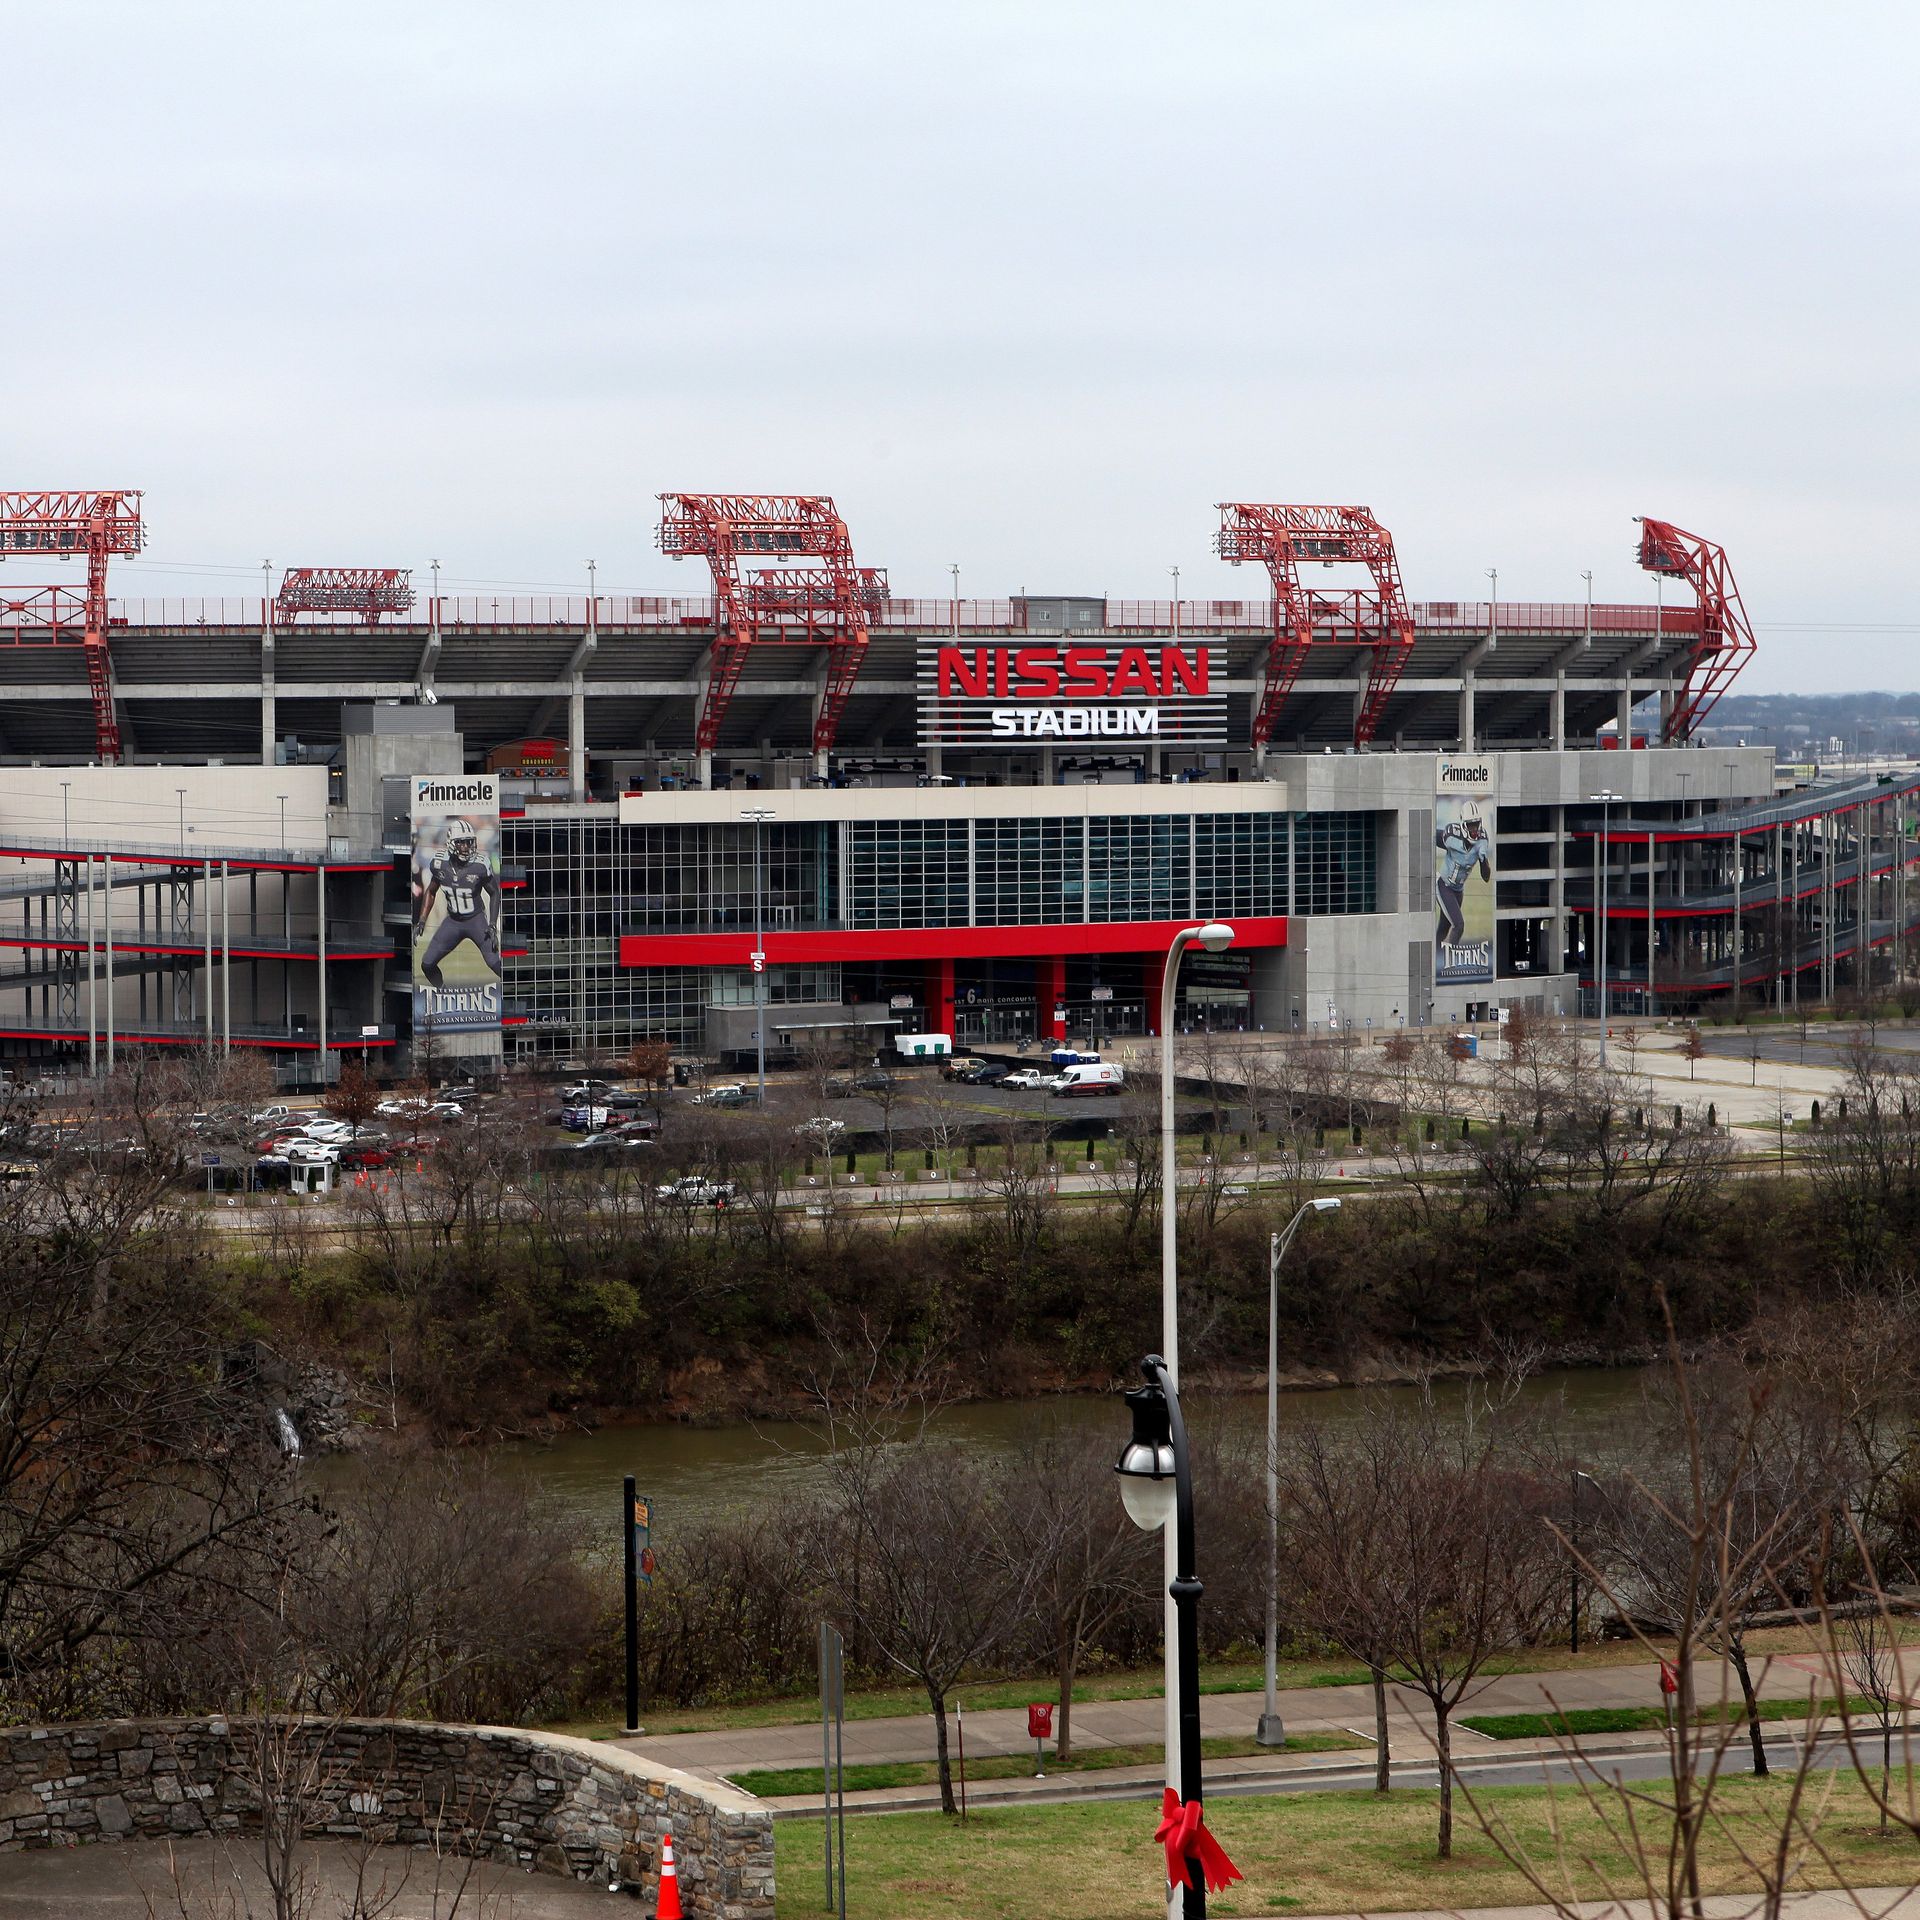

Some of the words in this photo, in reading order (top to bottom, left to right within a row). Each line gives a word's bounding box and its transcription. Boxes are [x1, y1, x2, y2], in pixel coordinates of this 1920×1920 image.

[938, 647, 1209, 697] NISSAN
[992, 708, 1159, 736] STADIUM
[1442, 764, 1488, 781] Pinnacle
[418, 781, 493, 801] Pinnacle
[754, 960, 762, 971] S
[1441, 940, 1489, 969] TITANS
[419, 983, 497, 1016] TITANS
[967, 988, 976, 1004] 6
